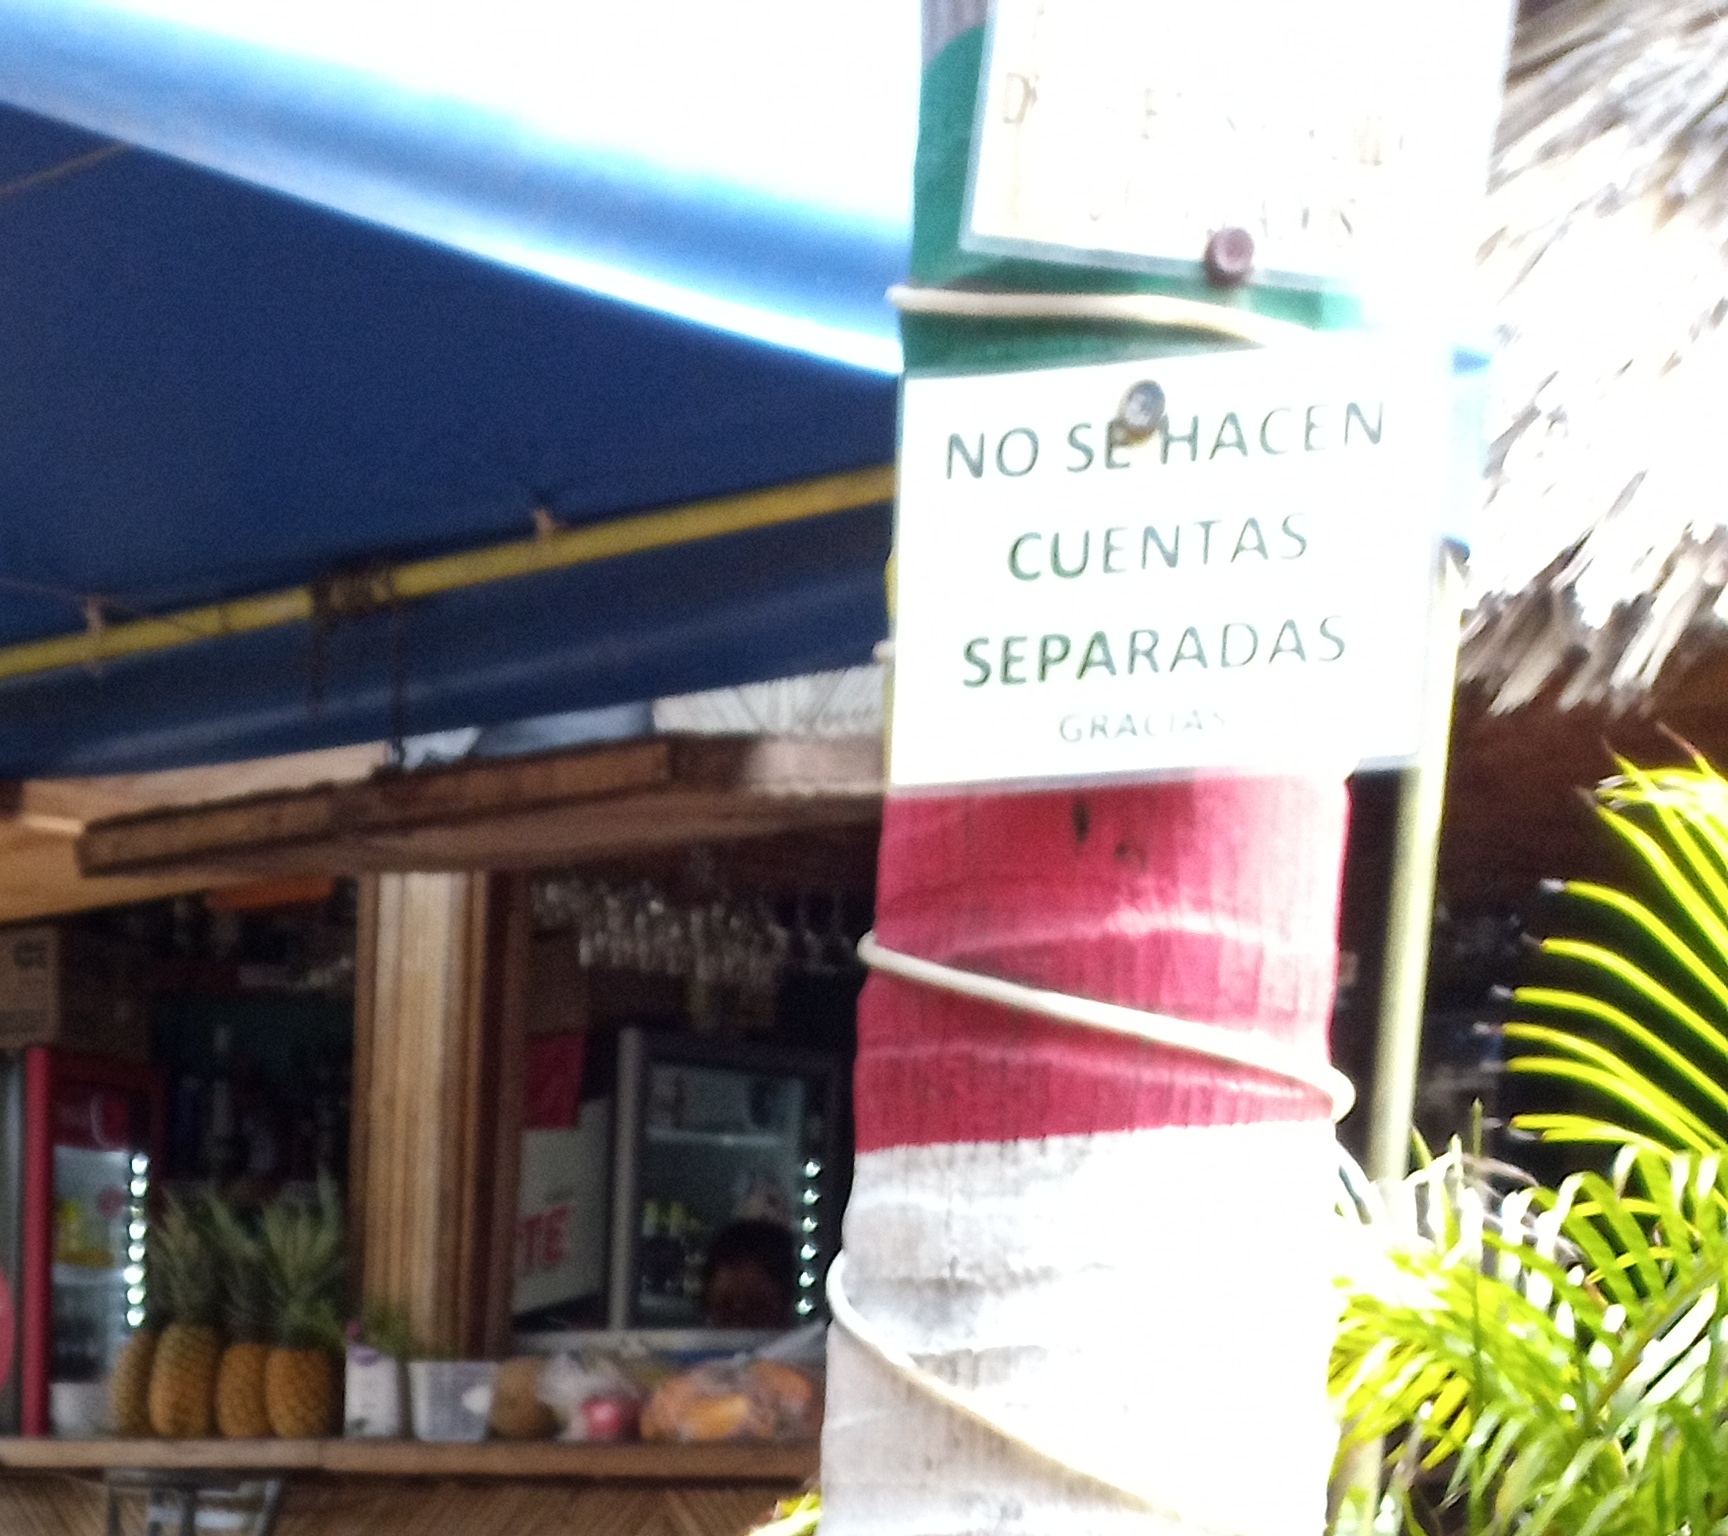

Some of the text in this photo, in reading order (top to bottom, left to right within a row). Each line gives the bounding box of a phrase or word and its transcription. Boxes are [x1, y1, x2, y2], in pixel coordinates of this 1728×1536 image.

[946, 401, 1385, 480] NO SE HACEN
[1007, 512, 1308, 581] CUENTAS
[962, 615, 1347, 688] SEPARADAS
